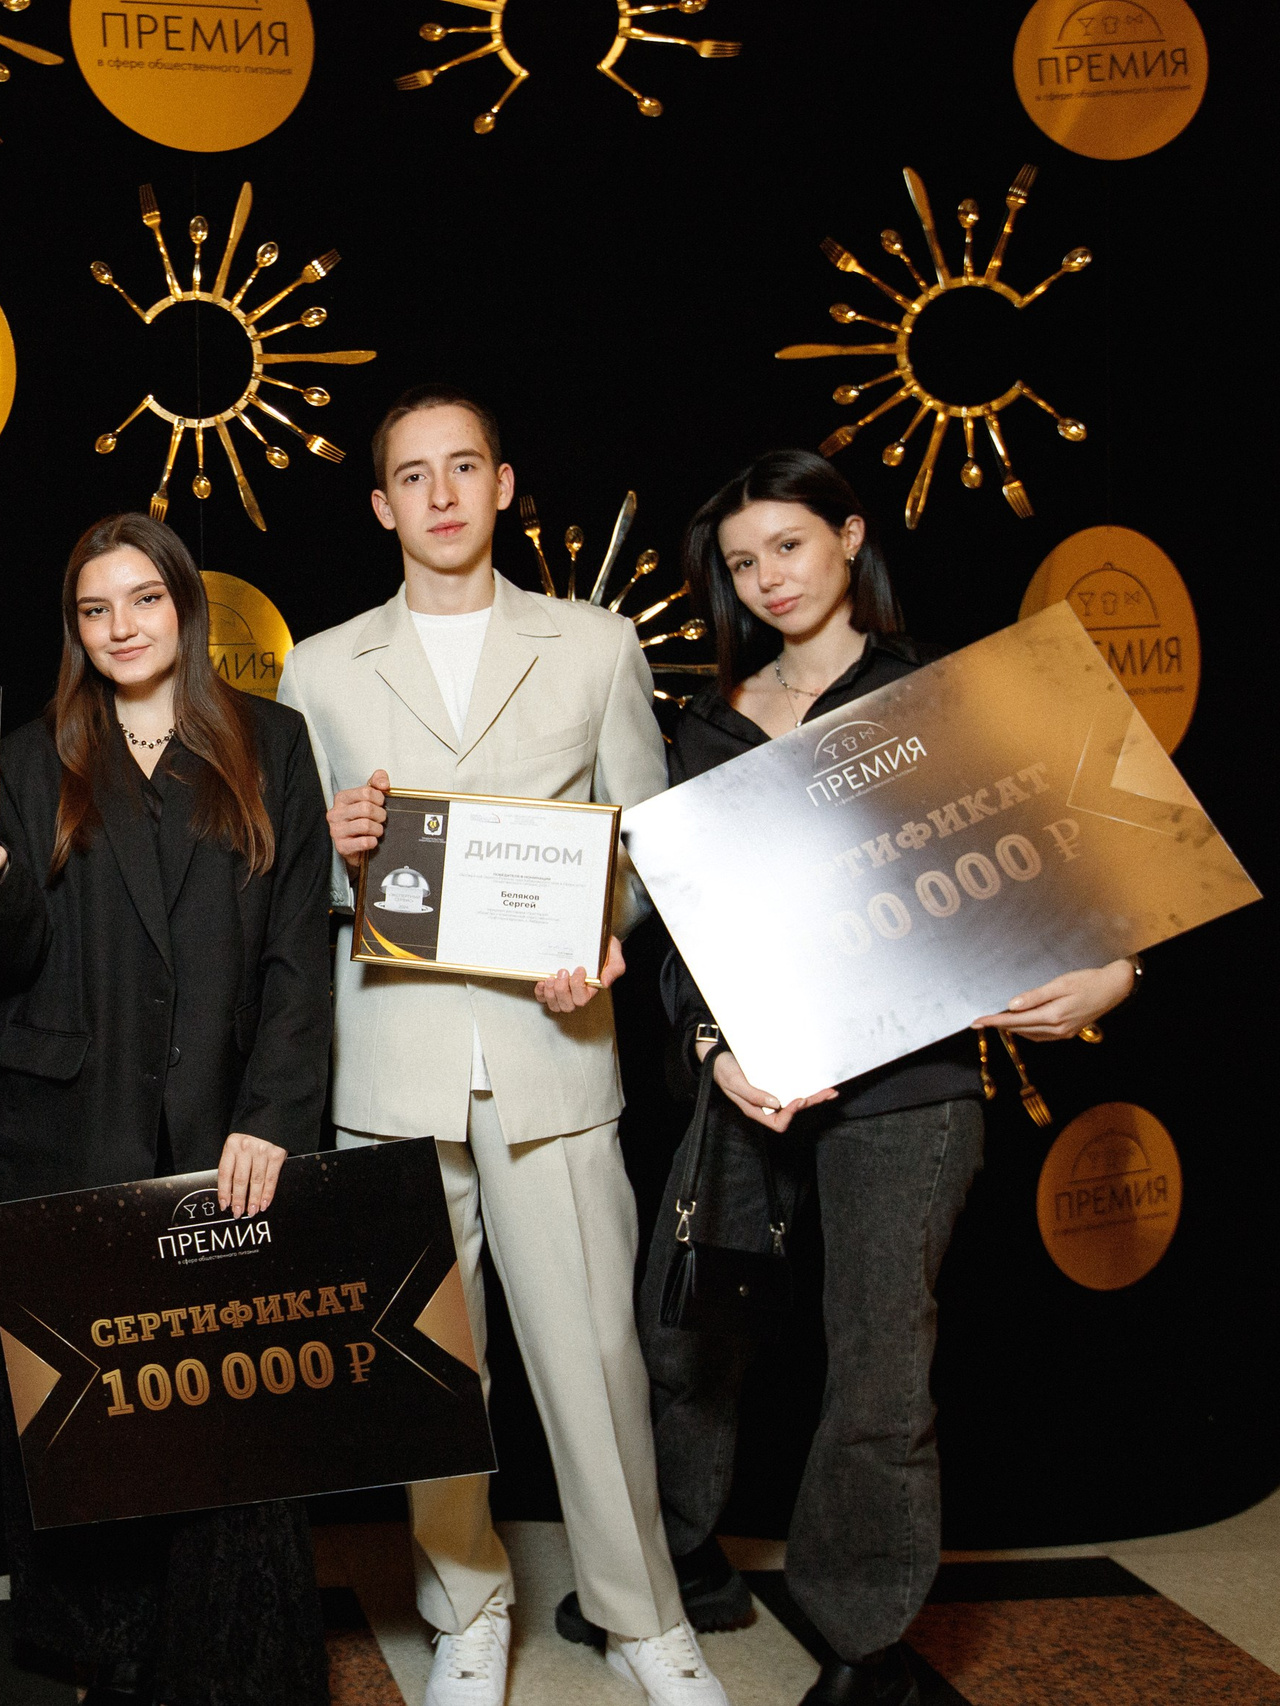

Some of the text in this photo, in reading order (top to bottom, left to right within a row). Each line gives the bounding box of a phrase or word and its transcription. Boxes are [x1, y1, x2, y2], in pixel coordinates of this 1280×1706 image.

[101, 12, 290, 57] ПРЕМИЯ
[97, 59, 104, 67] в
[107, 57, 145, 70] сфере
[148, 58, 241, 73] общественного
[1037, 48, 1189, 86] ПРЕМИЯ
[1094, 636, 1183, 675] МИЯ
[805, 736, 928, 807] ПРЕМИЯ
[833, 762, 1051, 880] ТИФИКАТ
[464, 840, 583, 866] ДИПЛОМ
[501, 890, 540, 901] Беляков
[502, 900, 537, 909] Сергей
[826, 892, 913, 957] 00
[915, 834, 1042, 918] 000
[1054, 1174, 1169, 1222] ПРЕМИЯ
[158, 1220, 272, 1259] ПРЕМИЯ
[90, 1281, 368, 1348] СЕРТИФИКАТ
[102, 1358, 211, 1417] 100
[222, 1340, 335, 1400] 000
